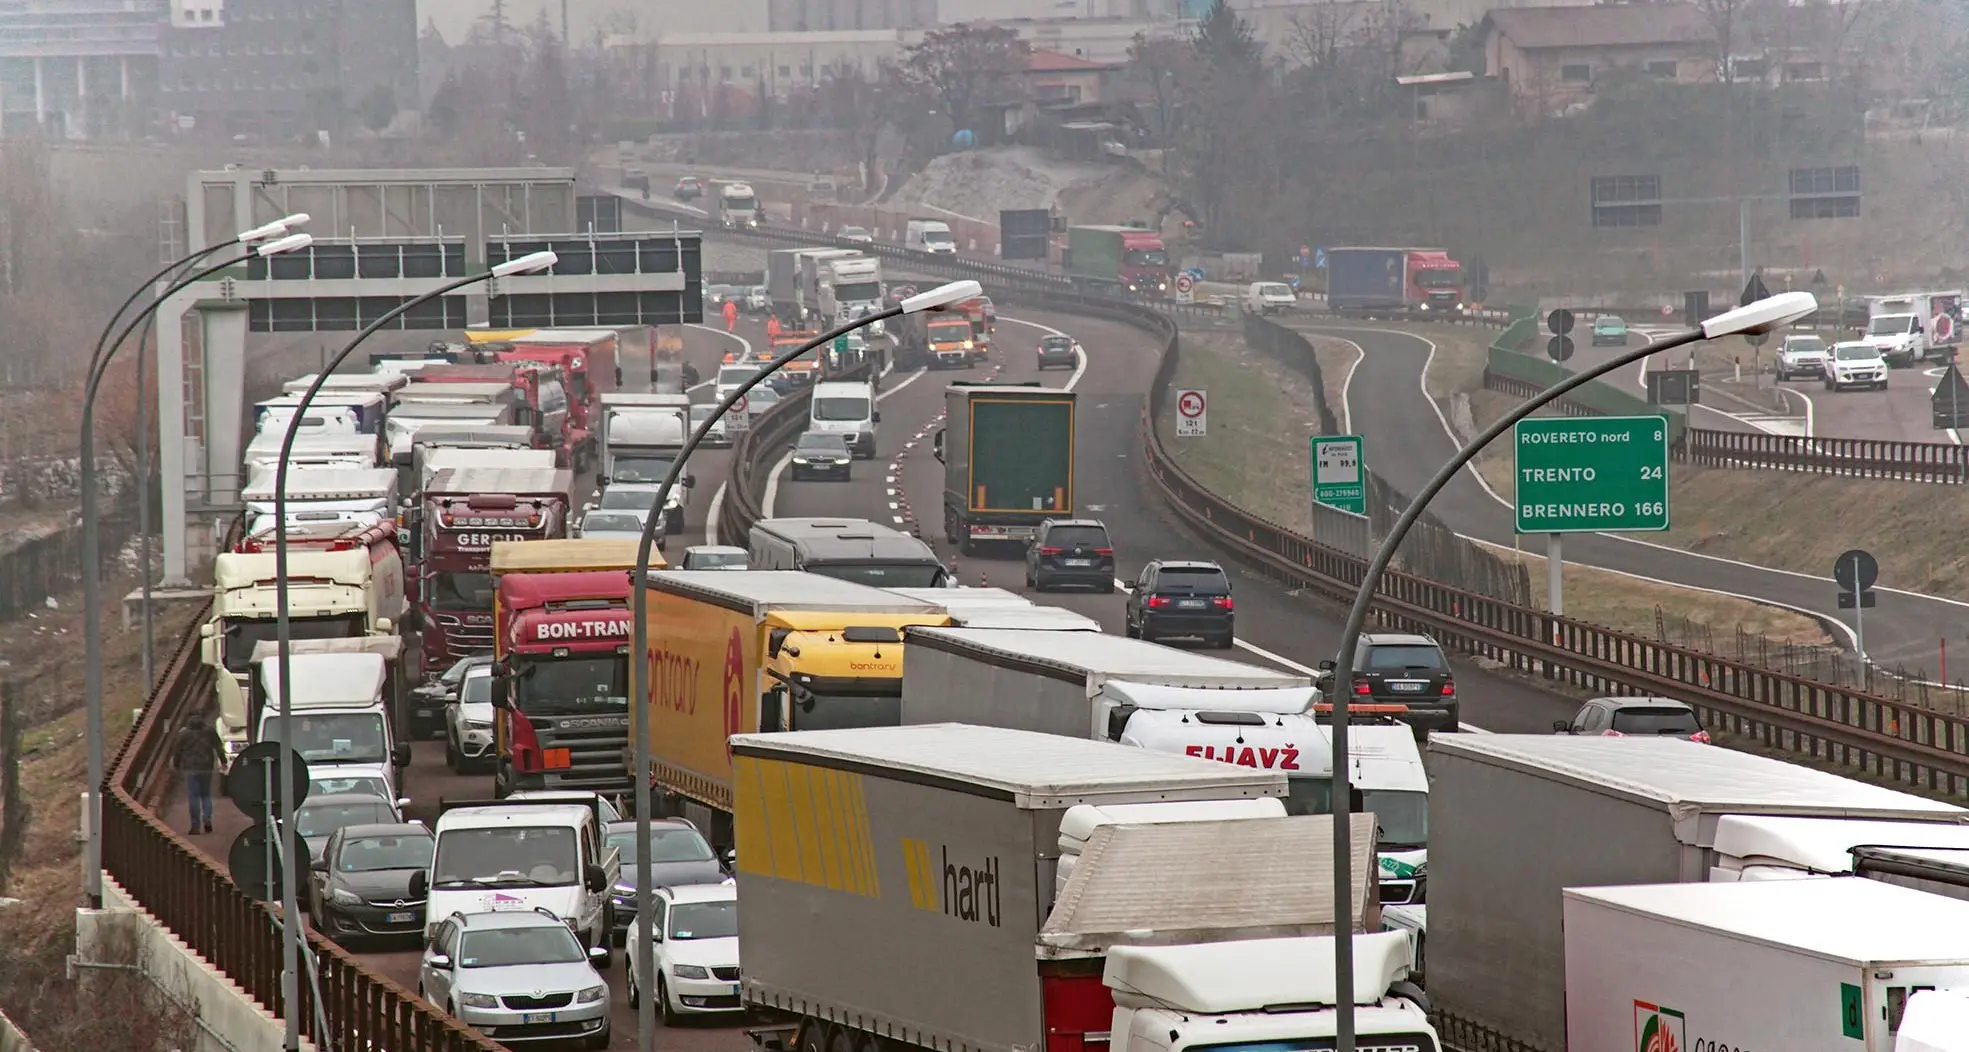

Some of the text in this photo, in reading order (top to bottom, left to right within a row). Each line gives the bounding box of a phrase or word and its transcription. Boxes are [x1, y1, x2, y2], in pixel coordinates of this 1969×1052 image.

[1521, 430, 1662, 444] ROVERETO nord 8
[1522, 466, 1663, 482] TRENTO 24
[1522, 502, 1663, 518] BRENNERO 166
[537, 621, 631, 639] BON-TRAN
[648, 640, 700, 716] ontrans
[570, 718, 620, 728] SCANIA
[942, 844, 1000, 927] hartl
